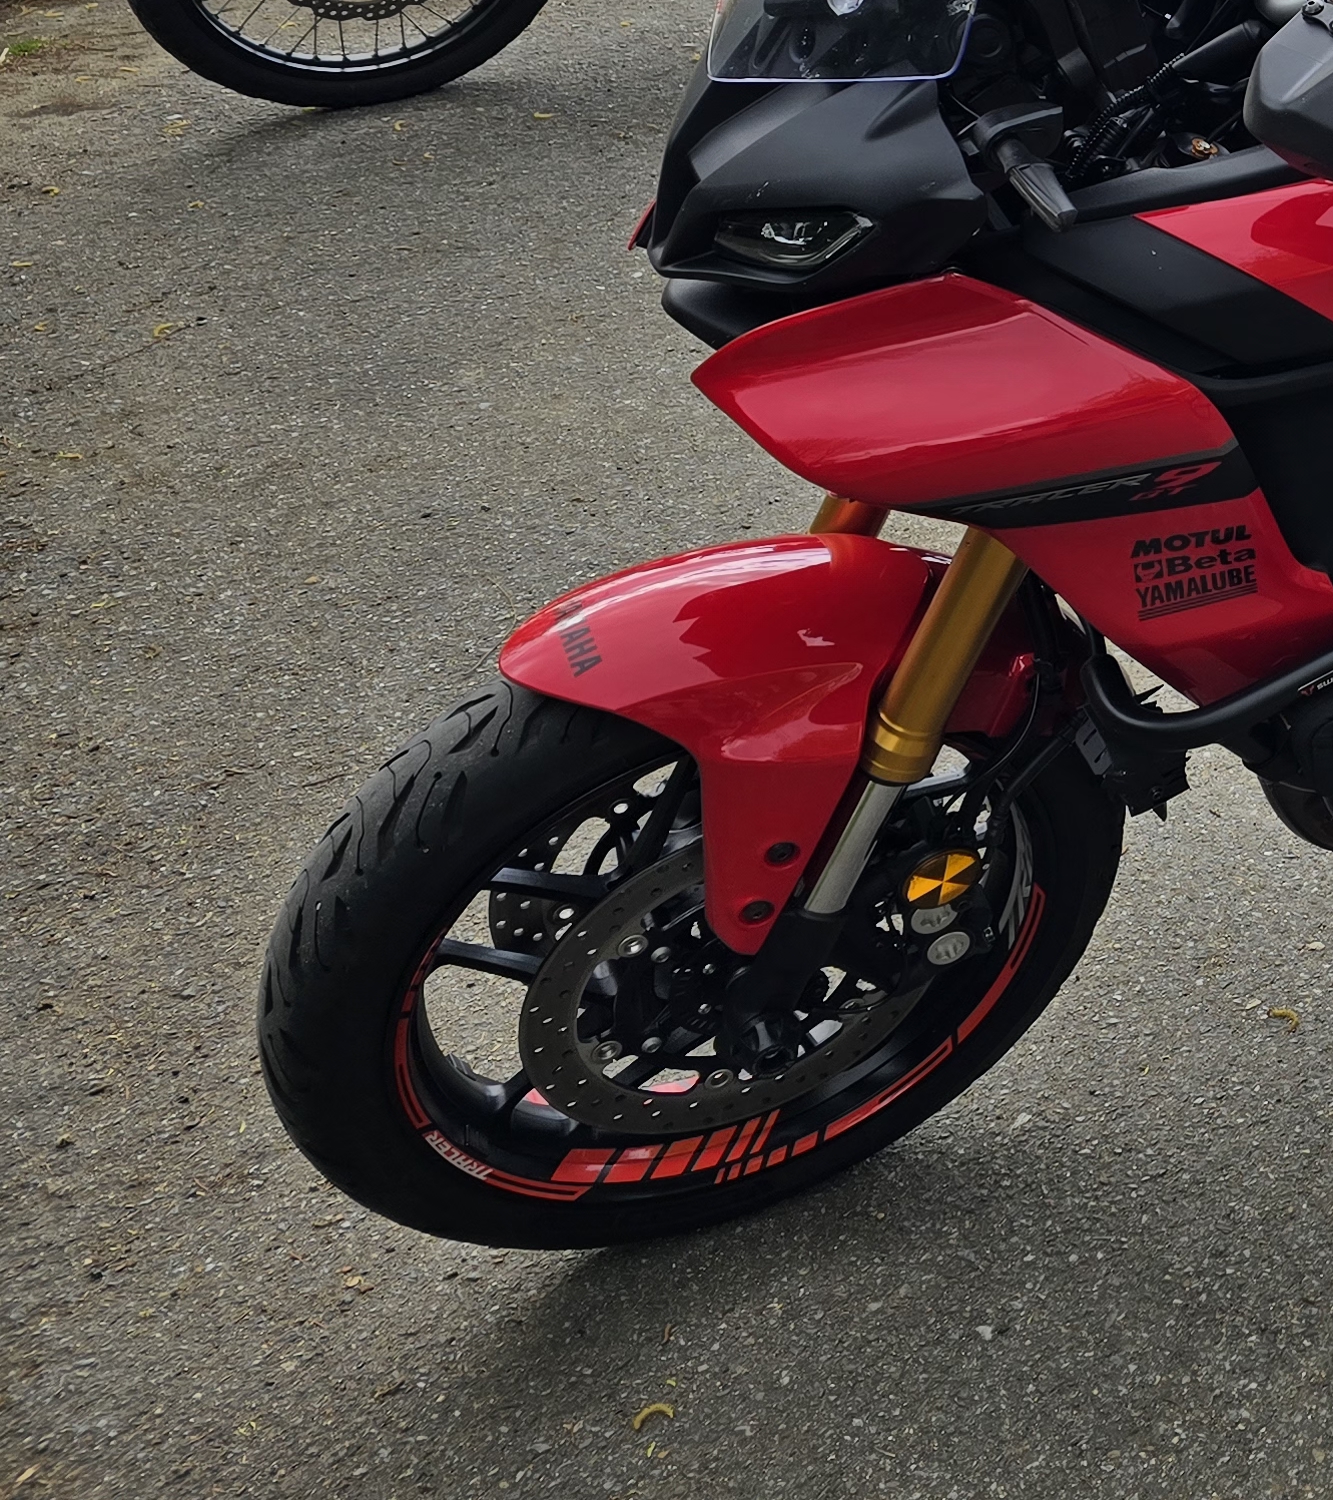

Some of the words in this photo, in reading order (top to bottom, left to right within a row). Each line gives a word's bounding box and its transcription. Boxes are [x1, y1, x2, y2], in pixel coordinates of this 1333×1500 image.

[1130, 525, 1252, 559] MOTUL
[1165, 548, 1256, 577] Beta
[1135, 565, 1257, 609] YAMALUBE
[424, 1131, 494, 1181] TRACER
